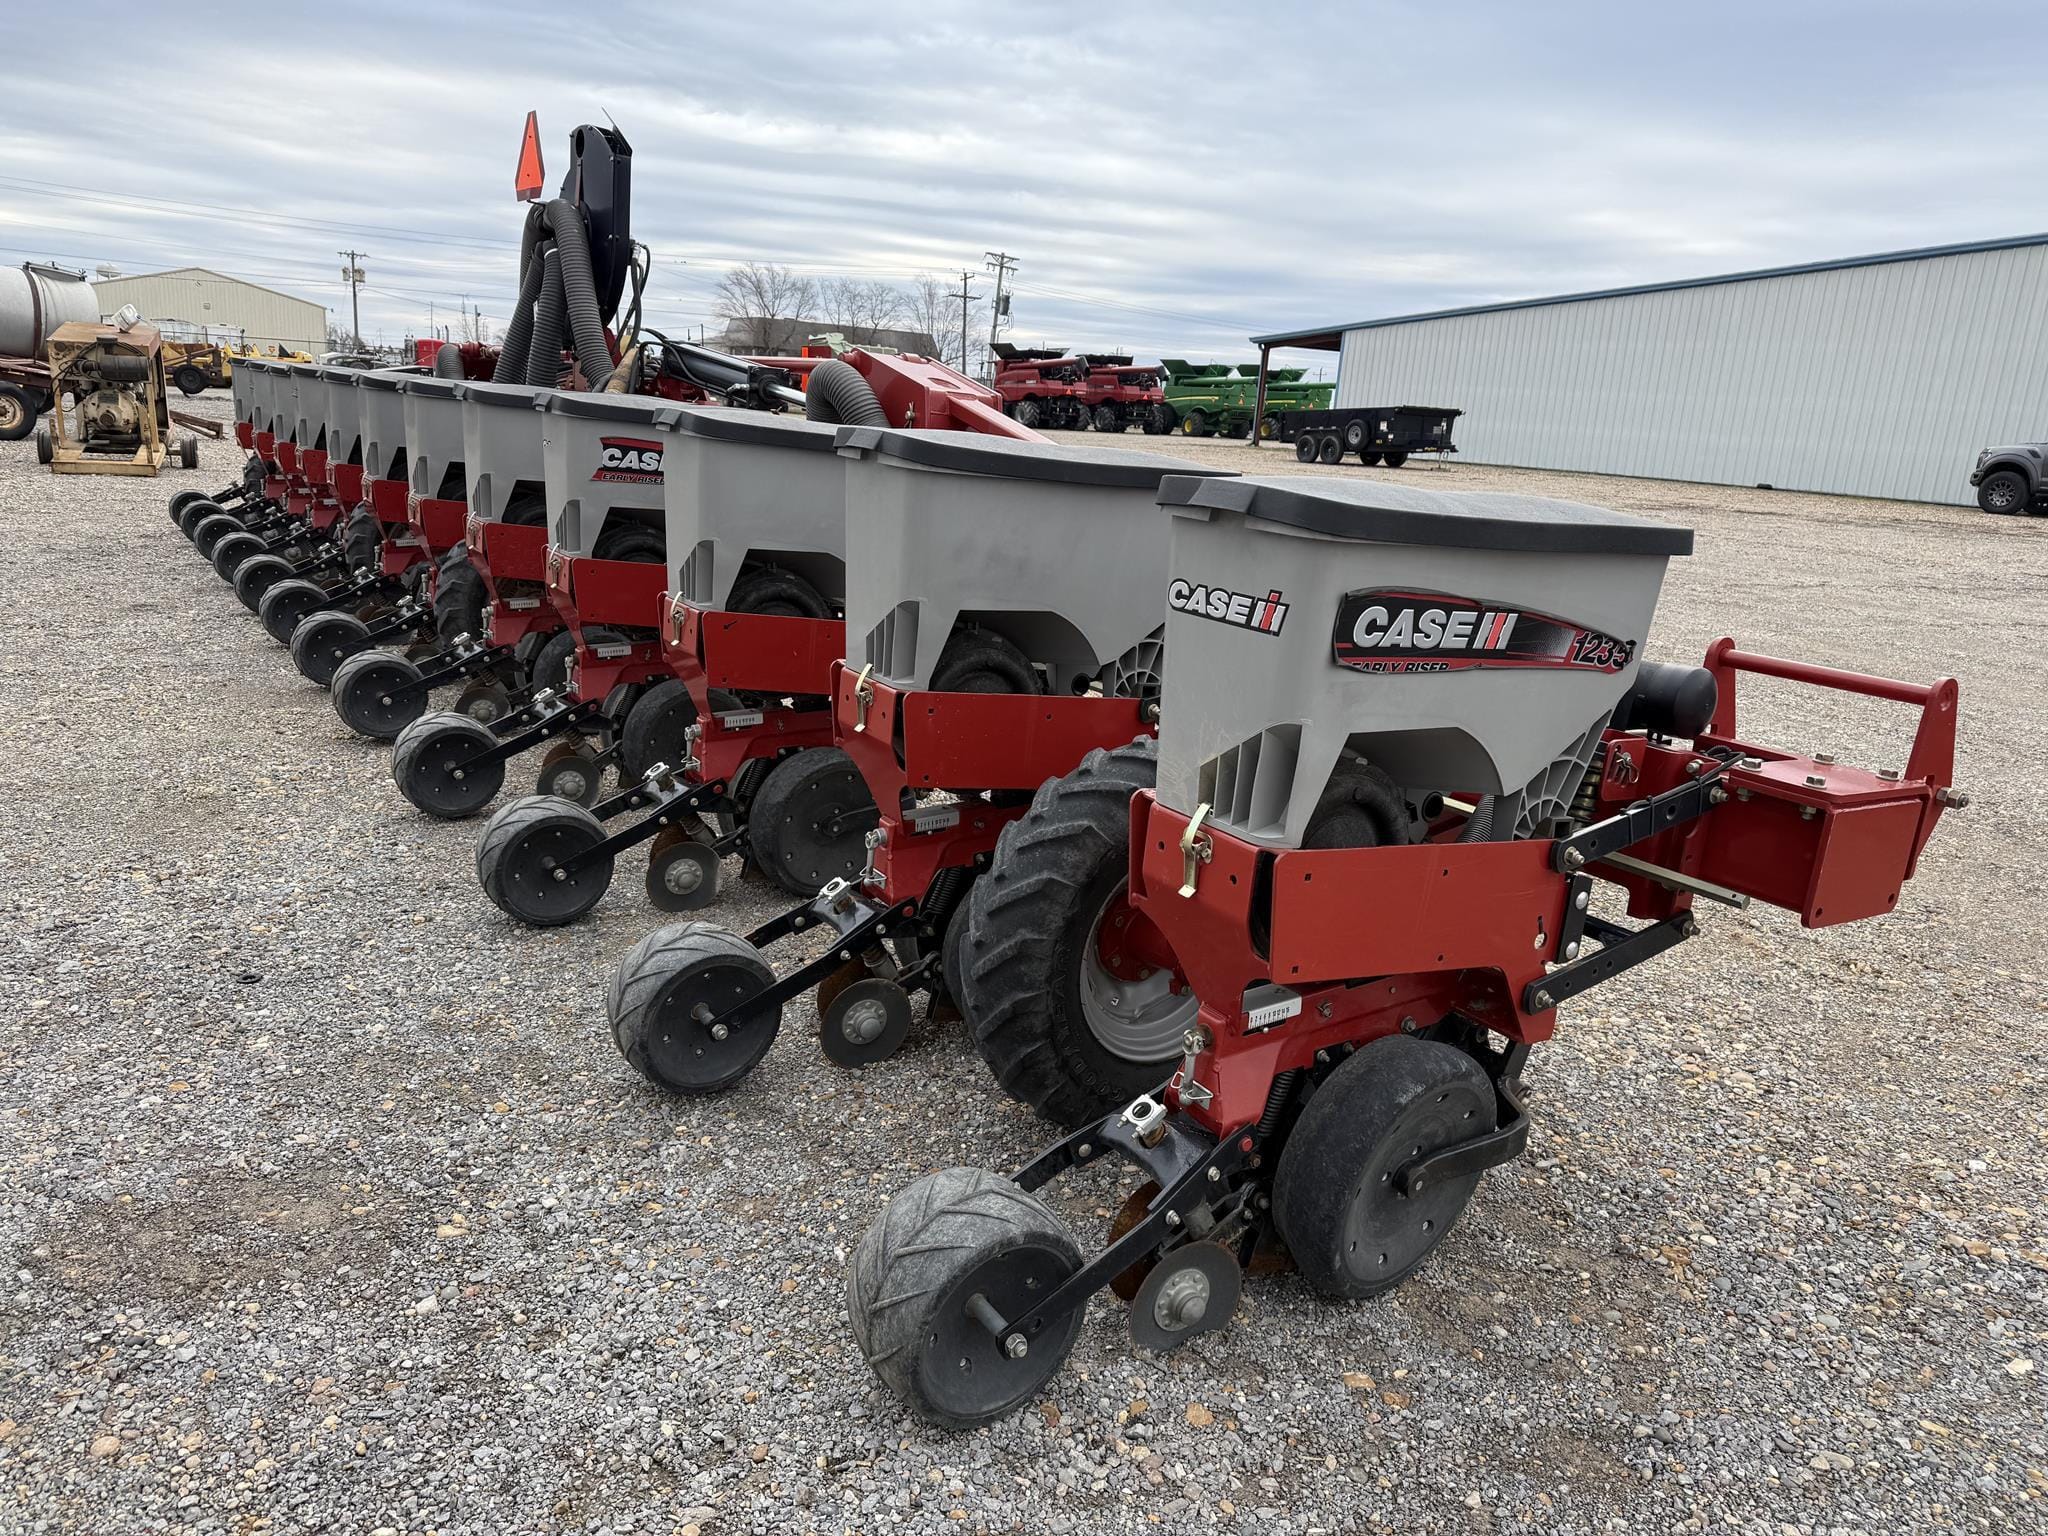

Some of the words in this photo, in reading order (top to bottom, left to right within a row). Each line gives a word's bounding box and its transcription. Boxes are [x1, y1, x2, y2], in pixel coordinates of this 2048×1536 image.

[602, 448, 664, 471] CAS
[603, 473, 635, 482] EARLY
[1168, 580, 1253, 625] CASE
[1353, 606, 1479, 649] CASE
[1571, 631, 1628, 669] 1235
[1352, 661, 1403, 671] ARLY
